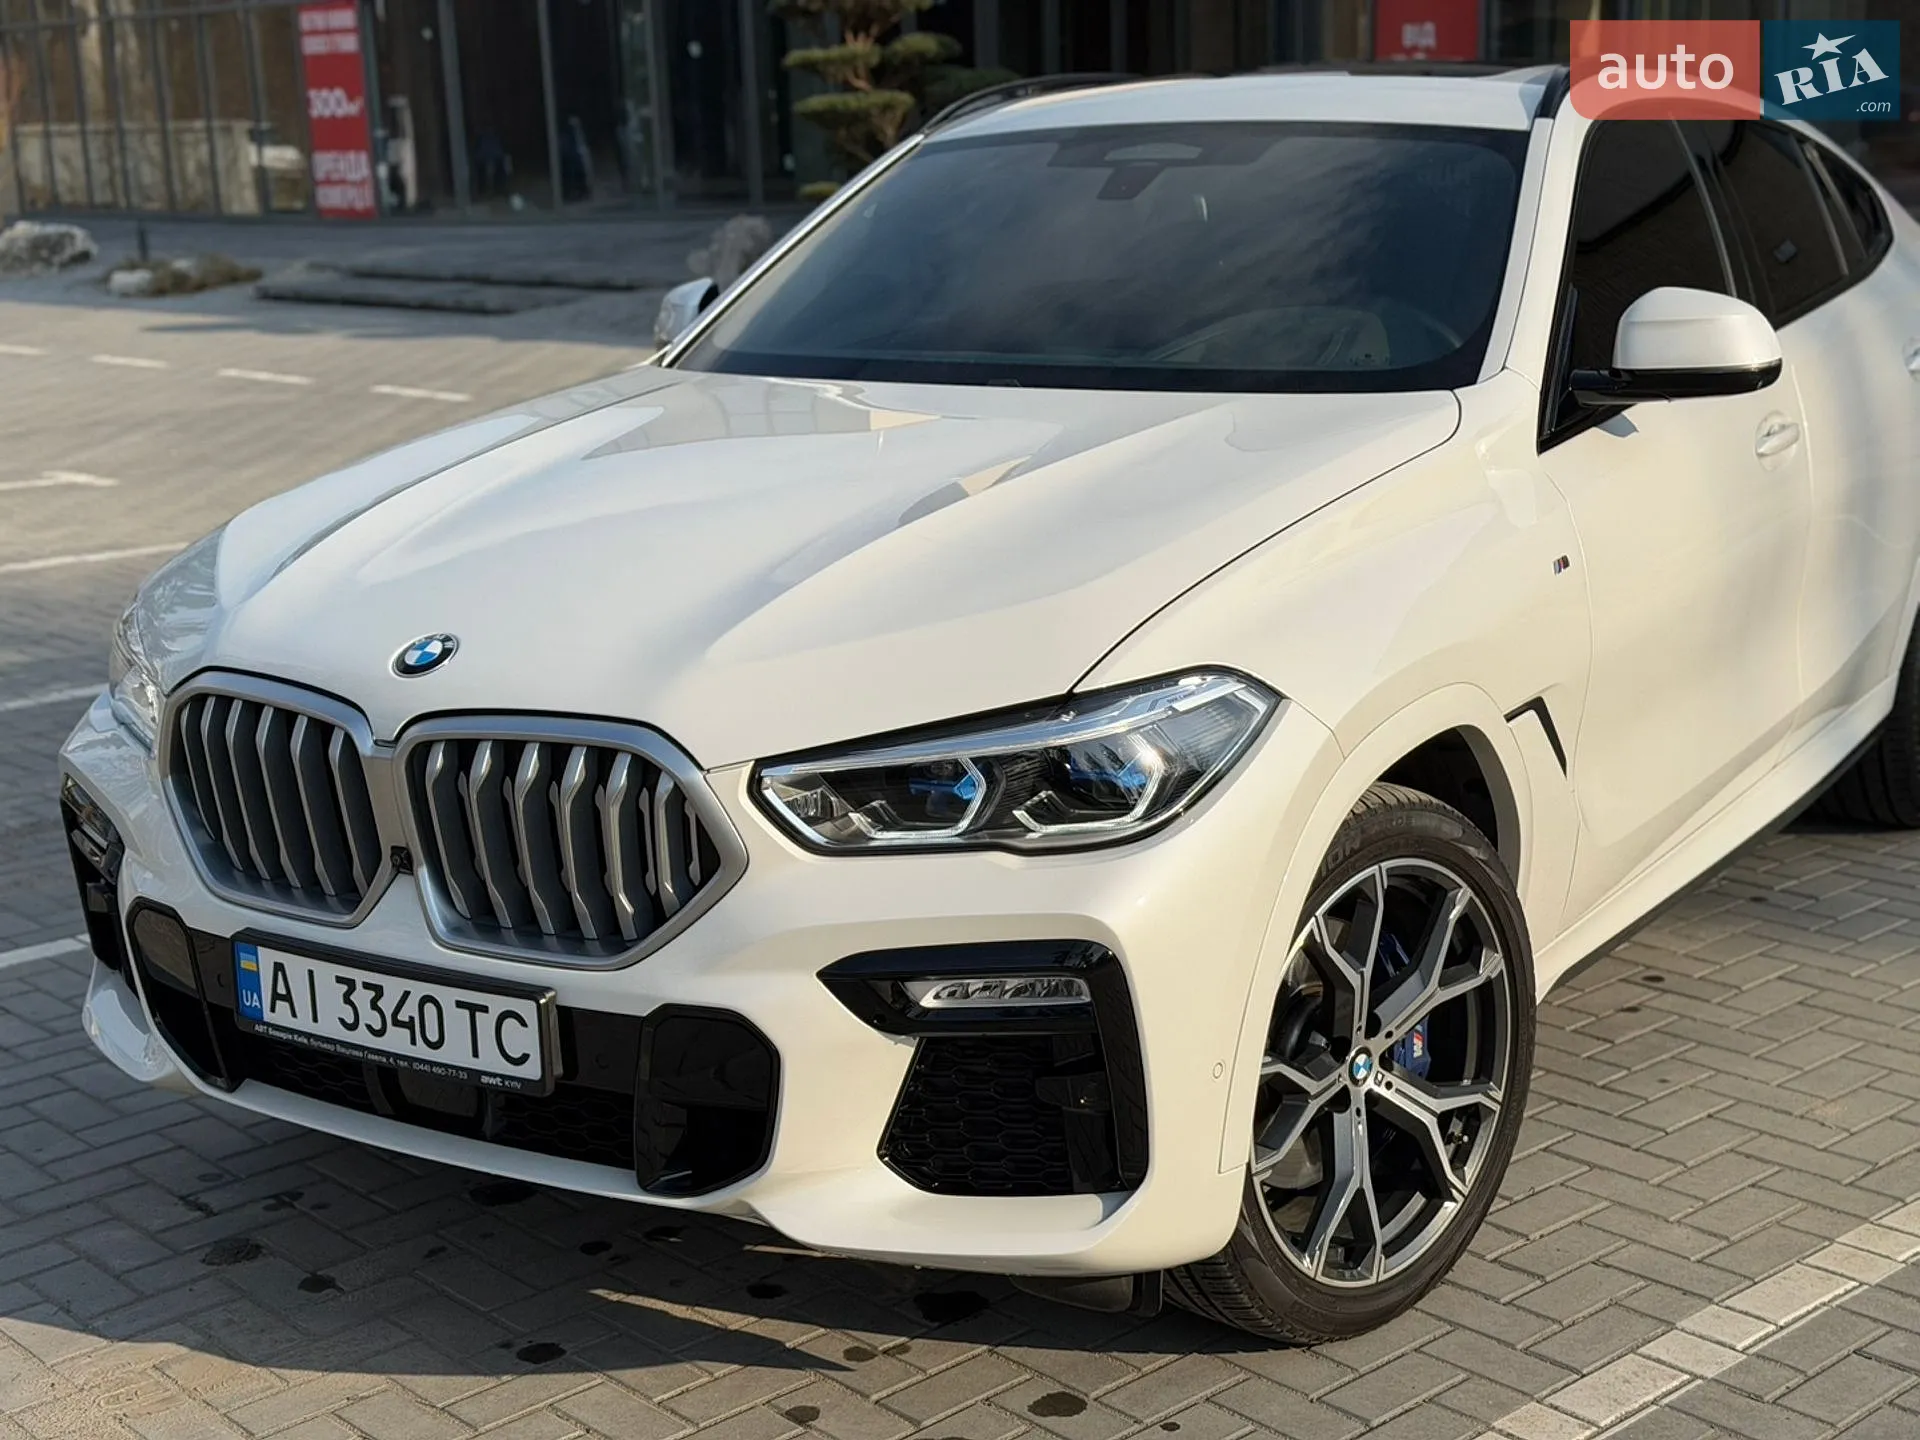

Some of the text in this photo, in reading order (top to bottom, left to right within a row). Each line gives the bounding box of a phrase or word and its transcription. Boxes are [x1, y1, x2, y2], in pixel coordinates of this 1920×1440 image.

[242, 988, 261, 1010] UA
[270, 961, 531, 1067] AI 3340 TC
[412, 1062, 431, 1073] (044)
[480, 1075, 503, 1086] awt
